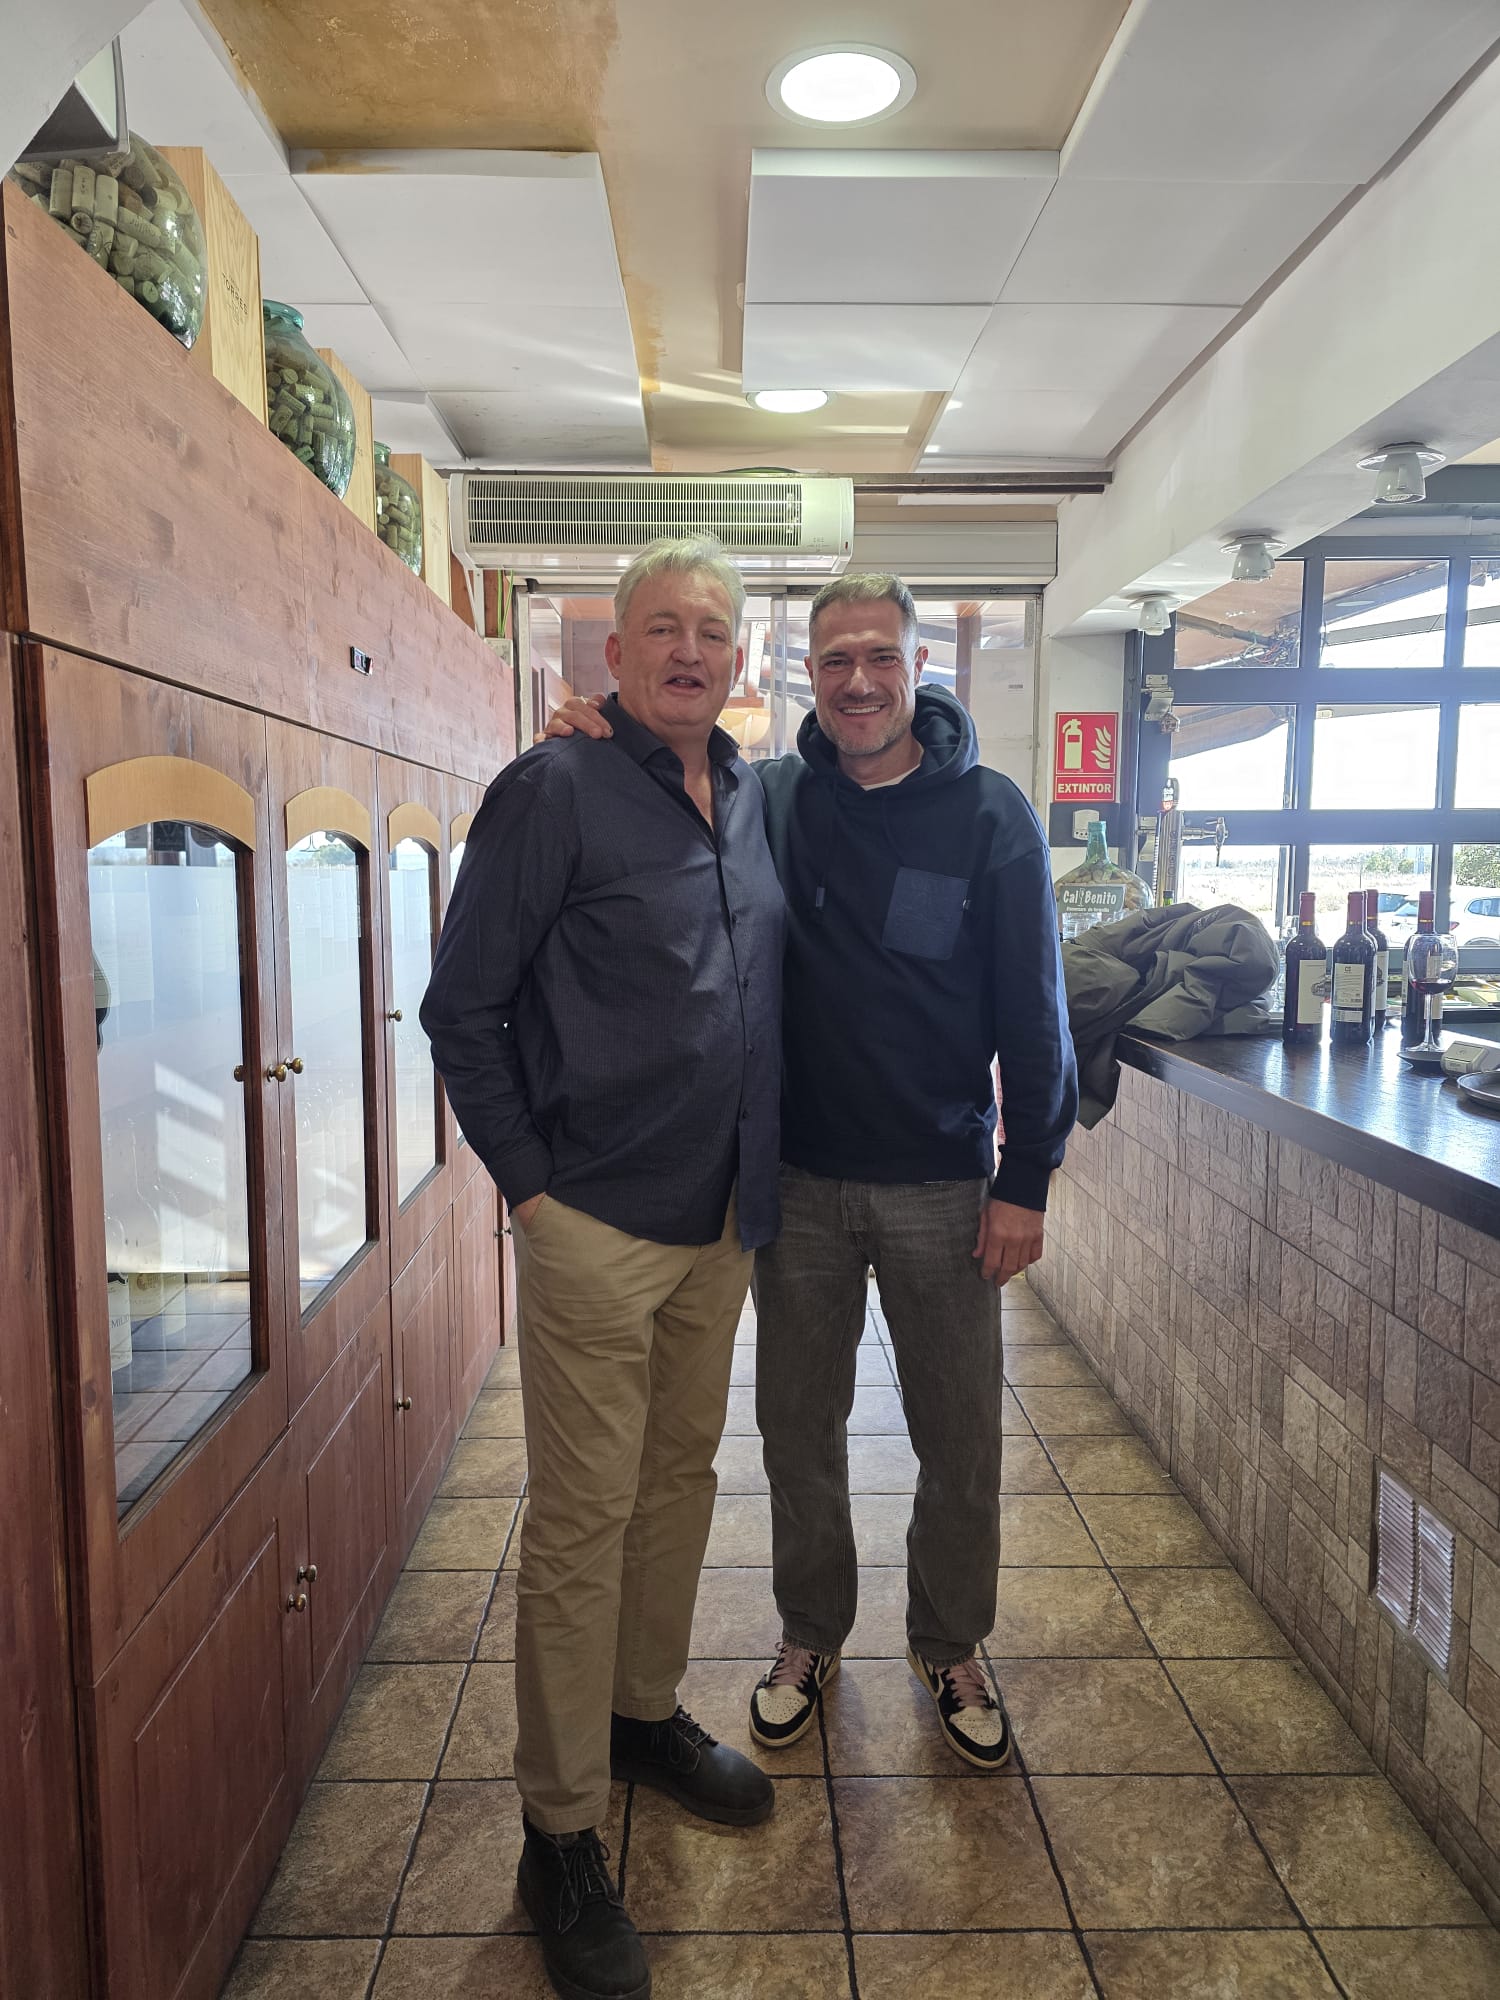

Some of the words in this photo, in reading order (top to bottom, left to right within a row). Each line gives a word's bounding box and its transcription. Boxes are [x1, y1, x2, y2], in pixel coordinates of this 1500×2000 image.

[1057, 783, 1112, 794] EXTINTOR
[1063, 890, 1078, 904] Cal
[1084, 890, 1117, 905] Benito
